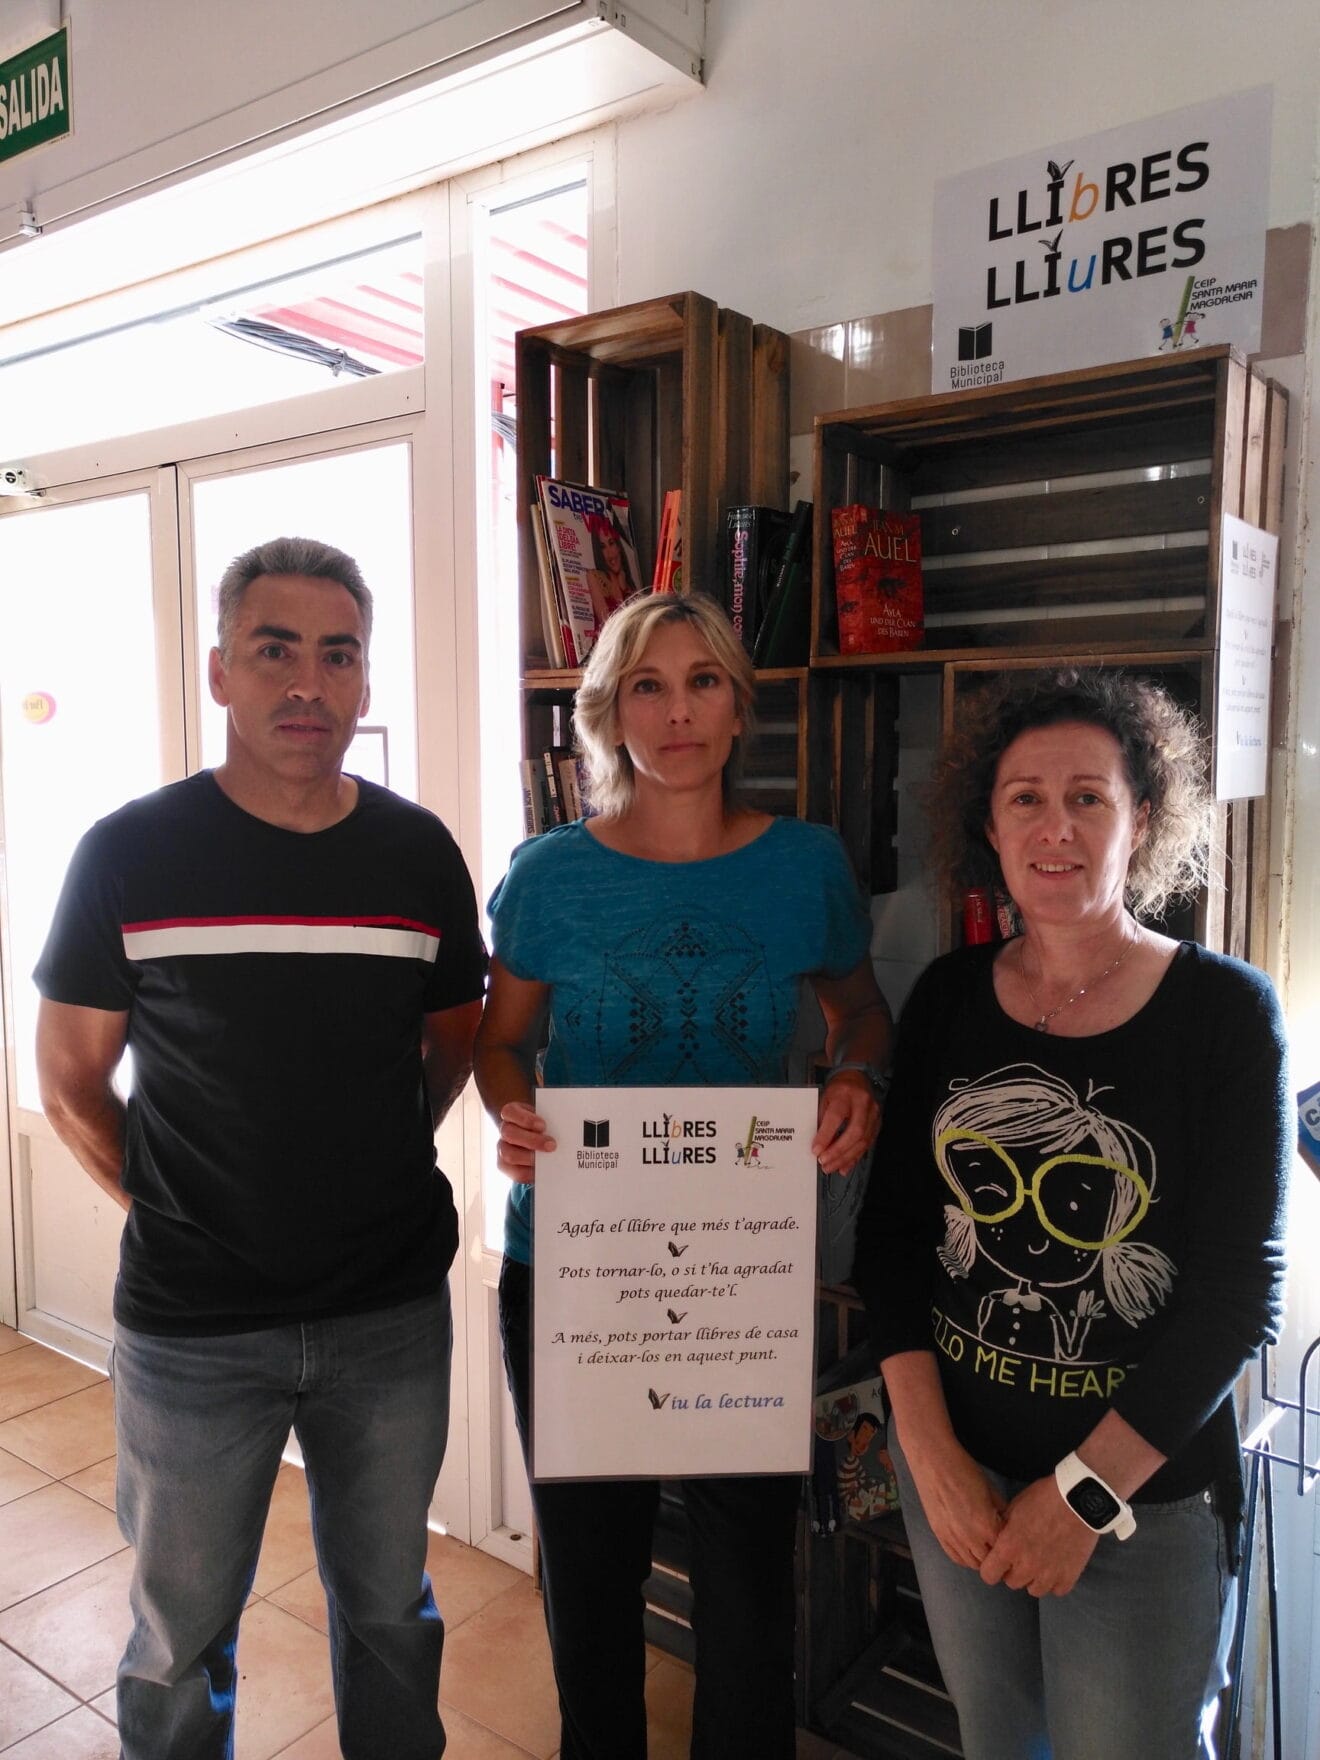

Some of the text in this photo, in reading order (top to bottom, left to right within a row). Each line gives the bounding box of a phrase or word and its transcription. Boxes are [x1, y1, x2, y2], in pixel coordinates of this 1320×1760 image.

[0, 56, 64, 140] SALIDA
[1191, 279, 1258, 300] SANTA MARIA
[1194, 278, 1217, 289] CEIP
[1189, 291, 1253, 310] MAGDALENA
[950, 360, 1004, 378] Biblioteca
[951, 371, 1003, 390] Municipal
[548, 485, 606, 516] SABER
[864, 531, 917, 563] AUEL
[576, 1150, 619, 1160] Biblioteca
[577, 1161, 618, 1171] Municipal
[557, 1219, 606, 1237] Agafa
[609, 1219, 626, 1233] el
[627, 1218, 666, 1233] llibre
[670, 1222, 696, 1236] que
[701, 1218, 730, 1231] més
[558, 1266, 591, 1279] Pots
[596, 1263, 666, 1278] tornar-lo,
[671, 1267, 680, 1276] o
[683, 1263, 697, 1276] si
[733, 1260, 793, 1279] agradat
[616, 1287, 650, 1303] pots
[552, 1325, 799, 1347] A més, pots portar llibres de casa
[577, 1349, 778, 1365] i deixar-los en aquest punt.
[974, 1345, 1022, 1386] ME
[1029, 1362, 1138, 1398] HEAR
[694, 1393, 713, 1409] la
[718, 1393, 785, 1409] lectura
